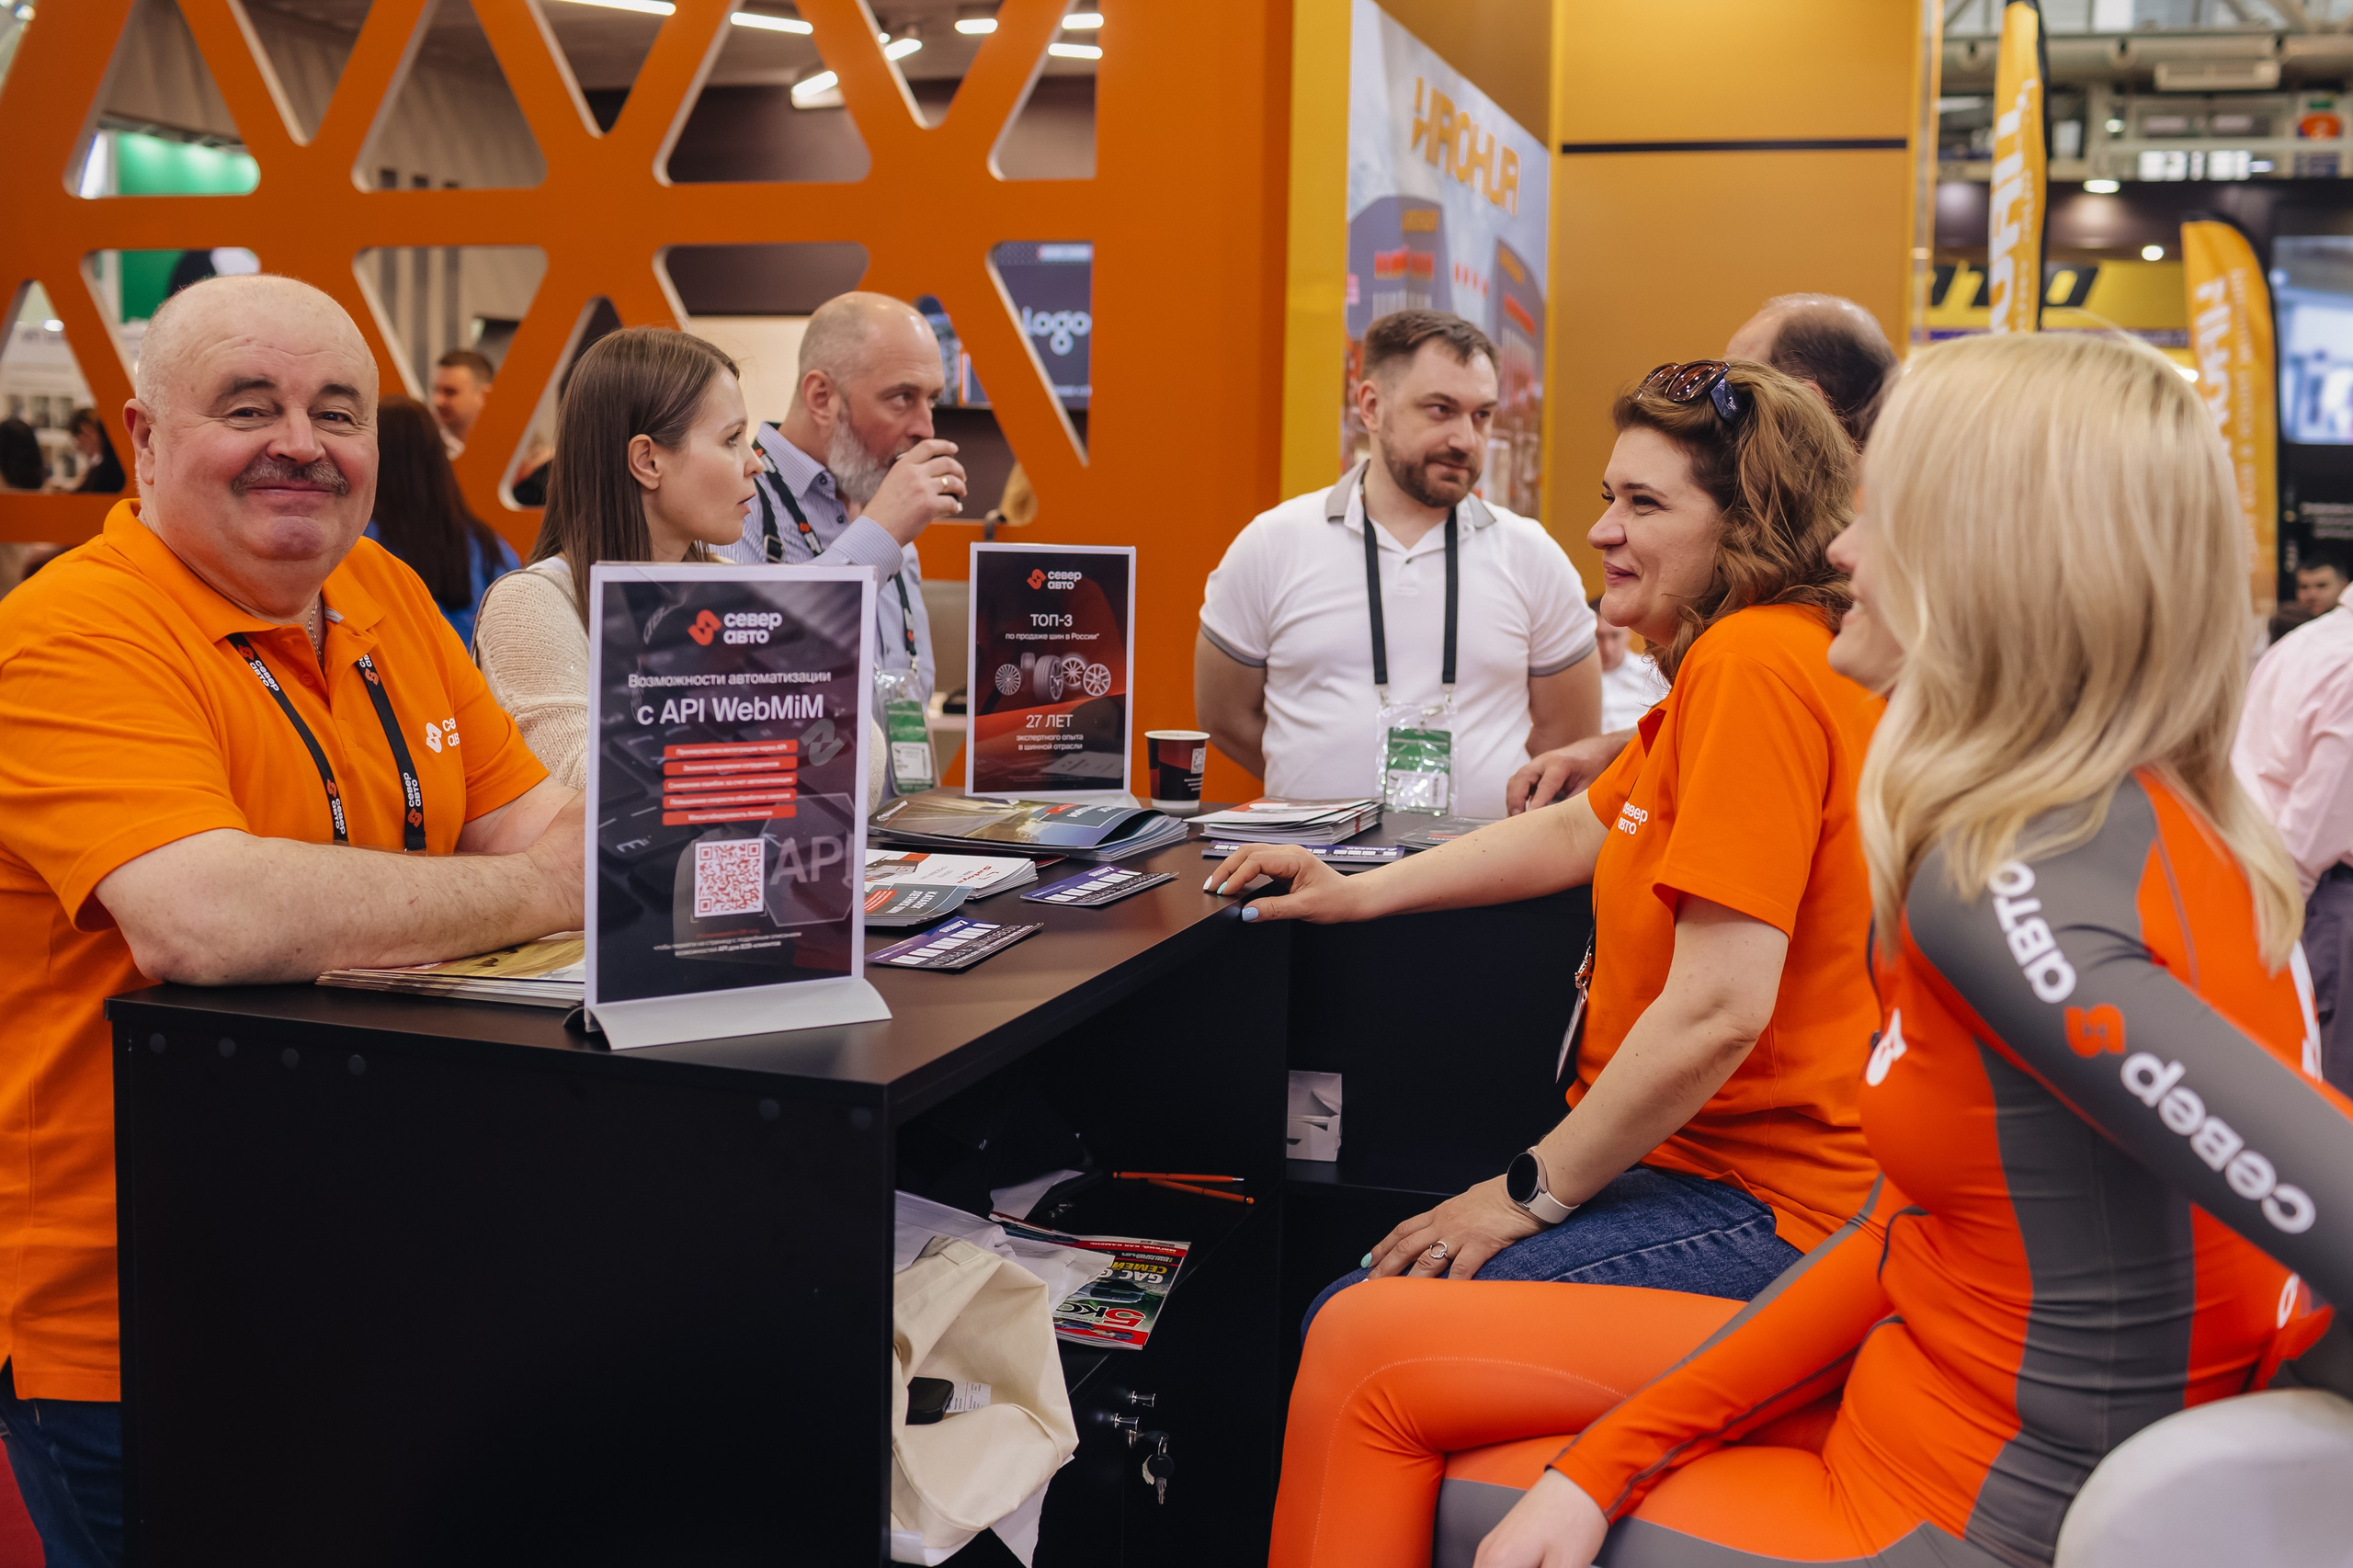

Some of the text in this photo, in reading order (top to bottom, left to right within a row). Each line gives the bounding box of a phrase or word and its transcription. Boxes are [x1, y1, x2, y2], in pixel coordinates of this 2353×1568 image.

[1022, 306, 1092, 356] logo
[1047, 571, 1082, 582] север
[1047, 581, 1074, 589] авто
[723, 612, 783, 631] север
[1030, 614, 1073, 627] ТОП-3
[722, 630, 769, 644] авто
[249, 662, 269, 687] авто
[255, 660, 279, 691] север
[628, 672, 831, 688] Возможности автоматизации
[637, 694, 824, 725] с API WebMiM
[1026, 714, 1074, 728] 27 ЛЕТ
[1024, 743, 1052, 751] шинной
[1053, 743, 1083, 751] отрасли
[404, 772, 415, 807] север
[411, 779, 421, 807] авто
[331, 800, 340, 829] авто
[335, 798, 346, 835] север
[1986, 861, 2077, 1004] авто
[2120, 1051, 2316, 1234] север
[1119, 1270, 1164, 1284] GAC
[1056, 1303, 1147, 1328] 5КО
